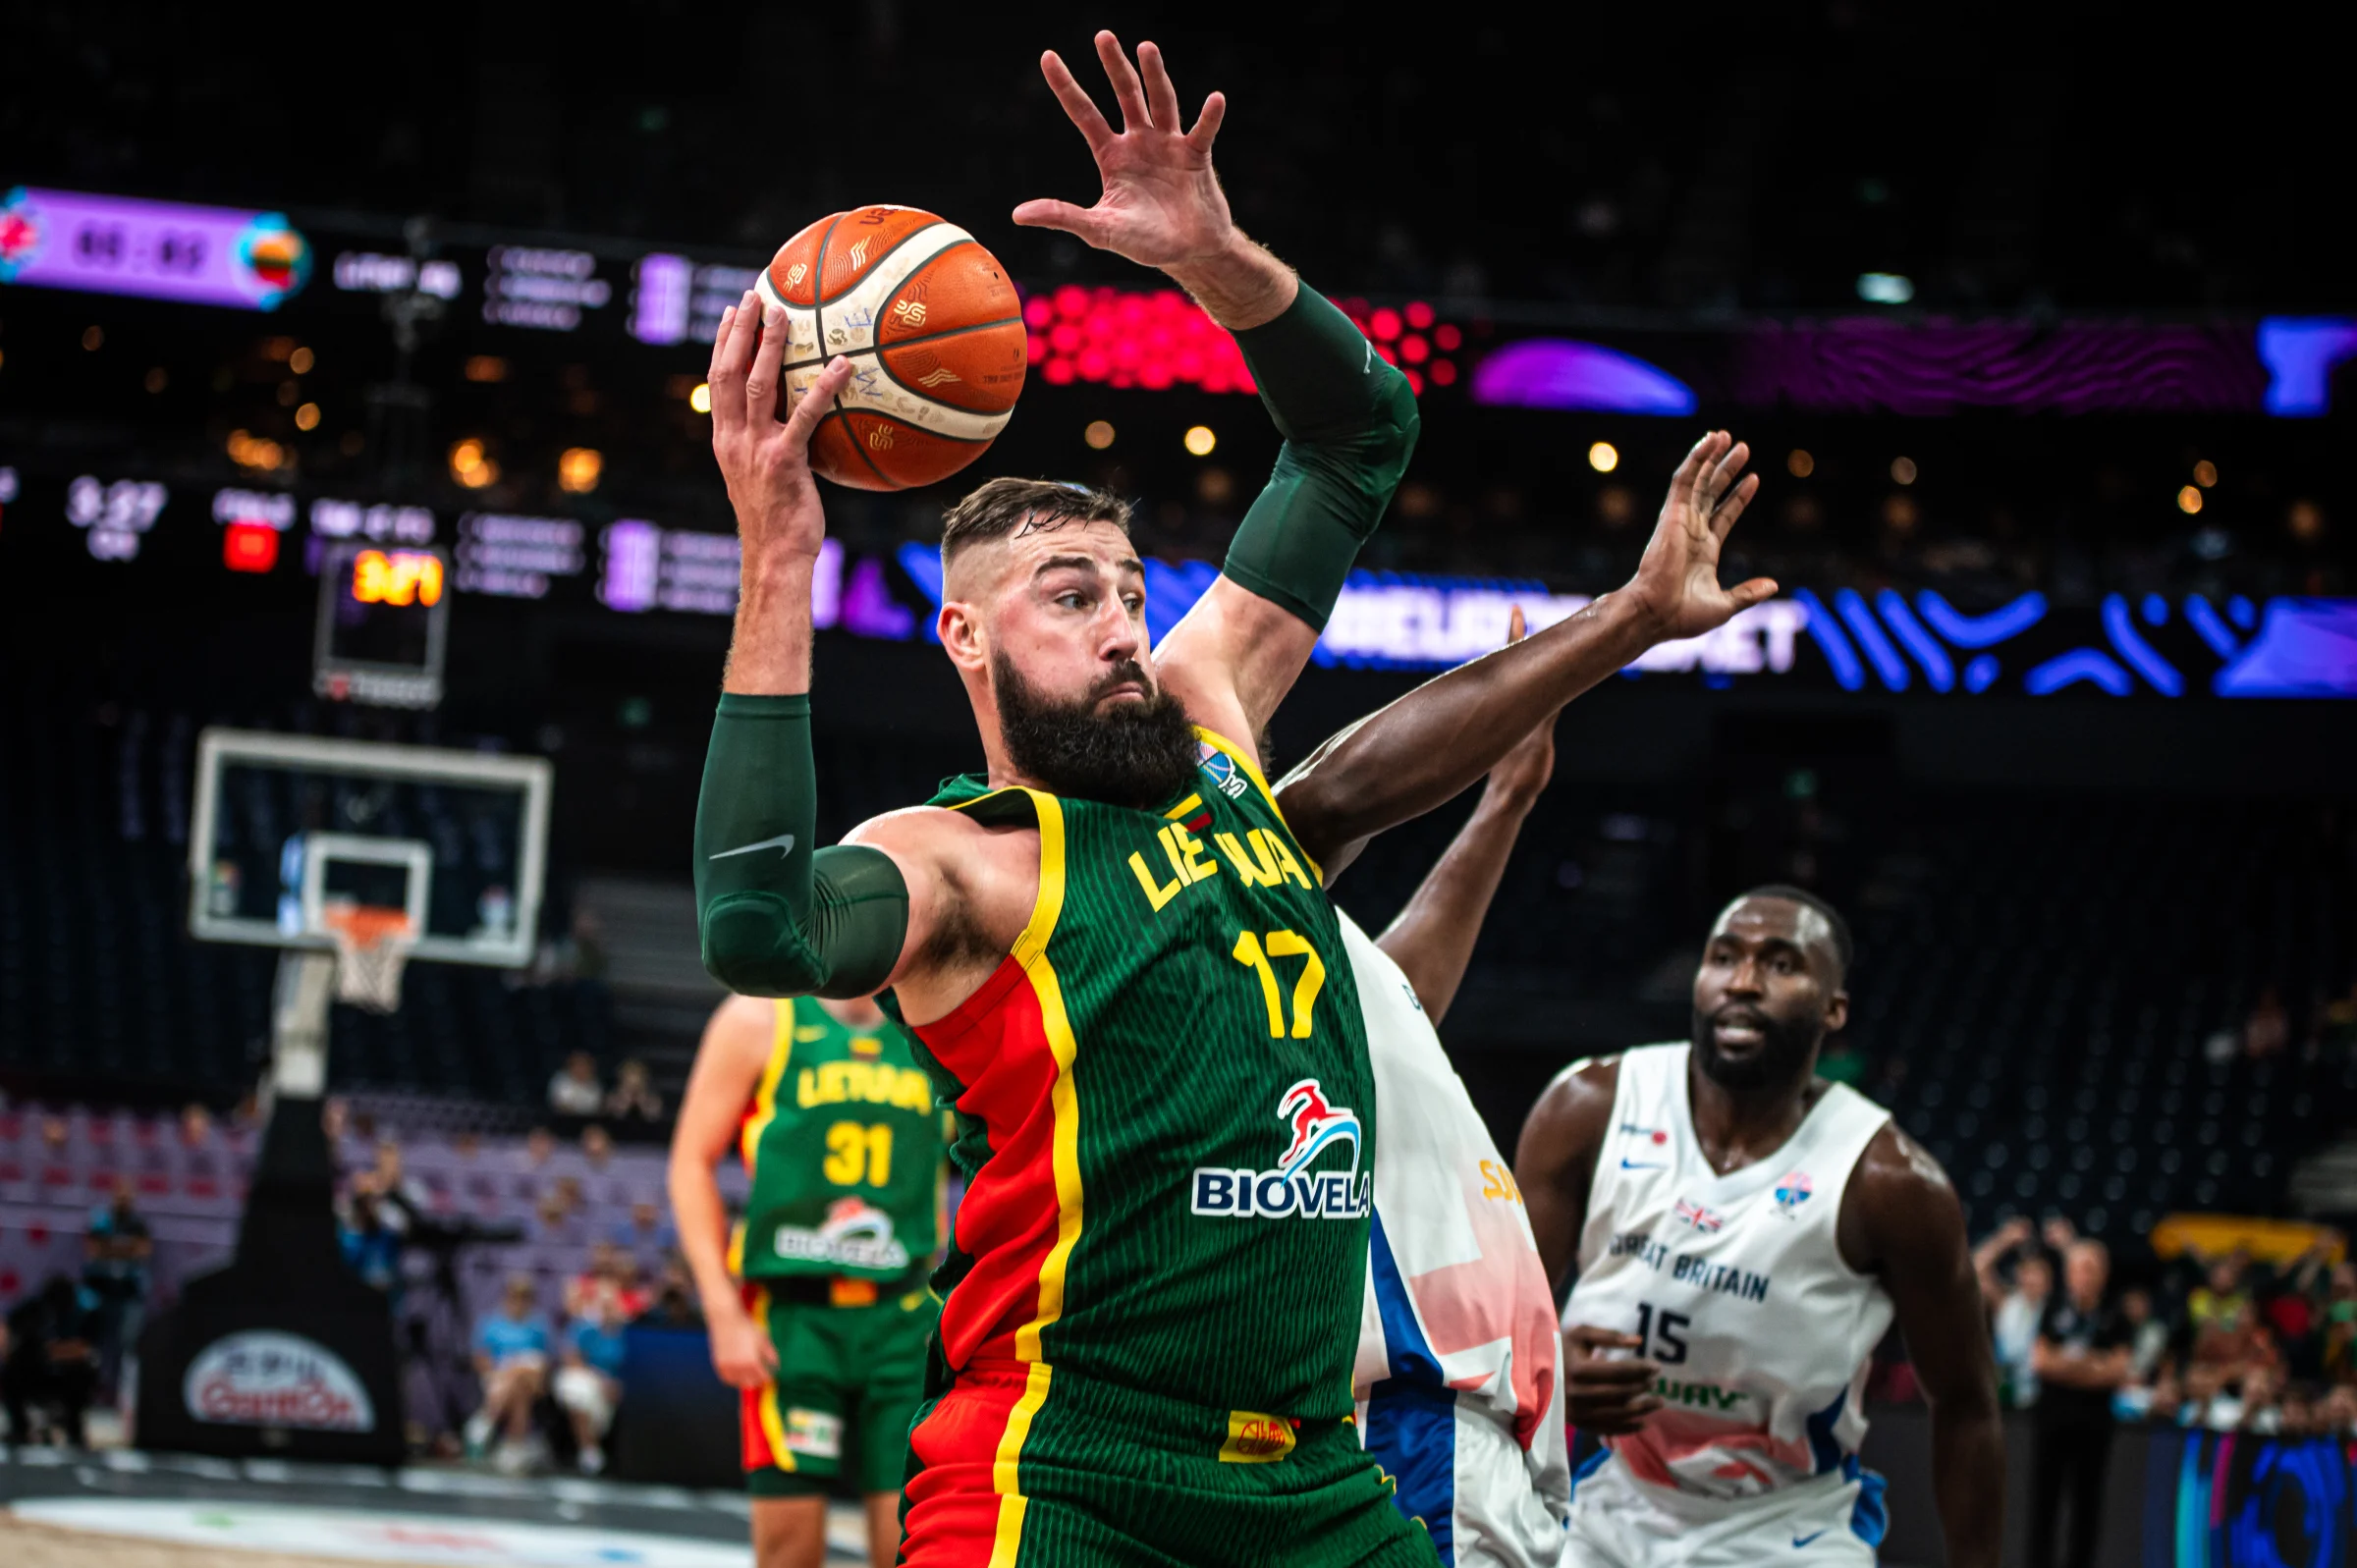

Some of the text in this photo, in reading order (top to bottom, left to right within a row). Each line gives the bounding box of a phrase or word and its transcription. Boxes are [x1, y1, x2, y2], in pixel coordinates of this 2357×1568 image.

[1233, 930, 1326, 1039] 17
[823, 1121, 893, 1187] 31
[1192, 1167, 1371, 1218] BIOVELA
[1610, 1233, 1770, 1303] GREAT BRITAIN
[1634, 1300, 1691, 1365] 15
